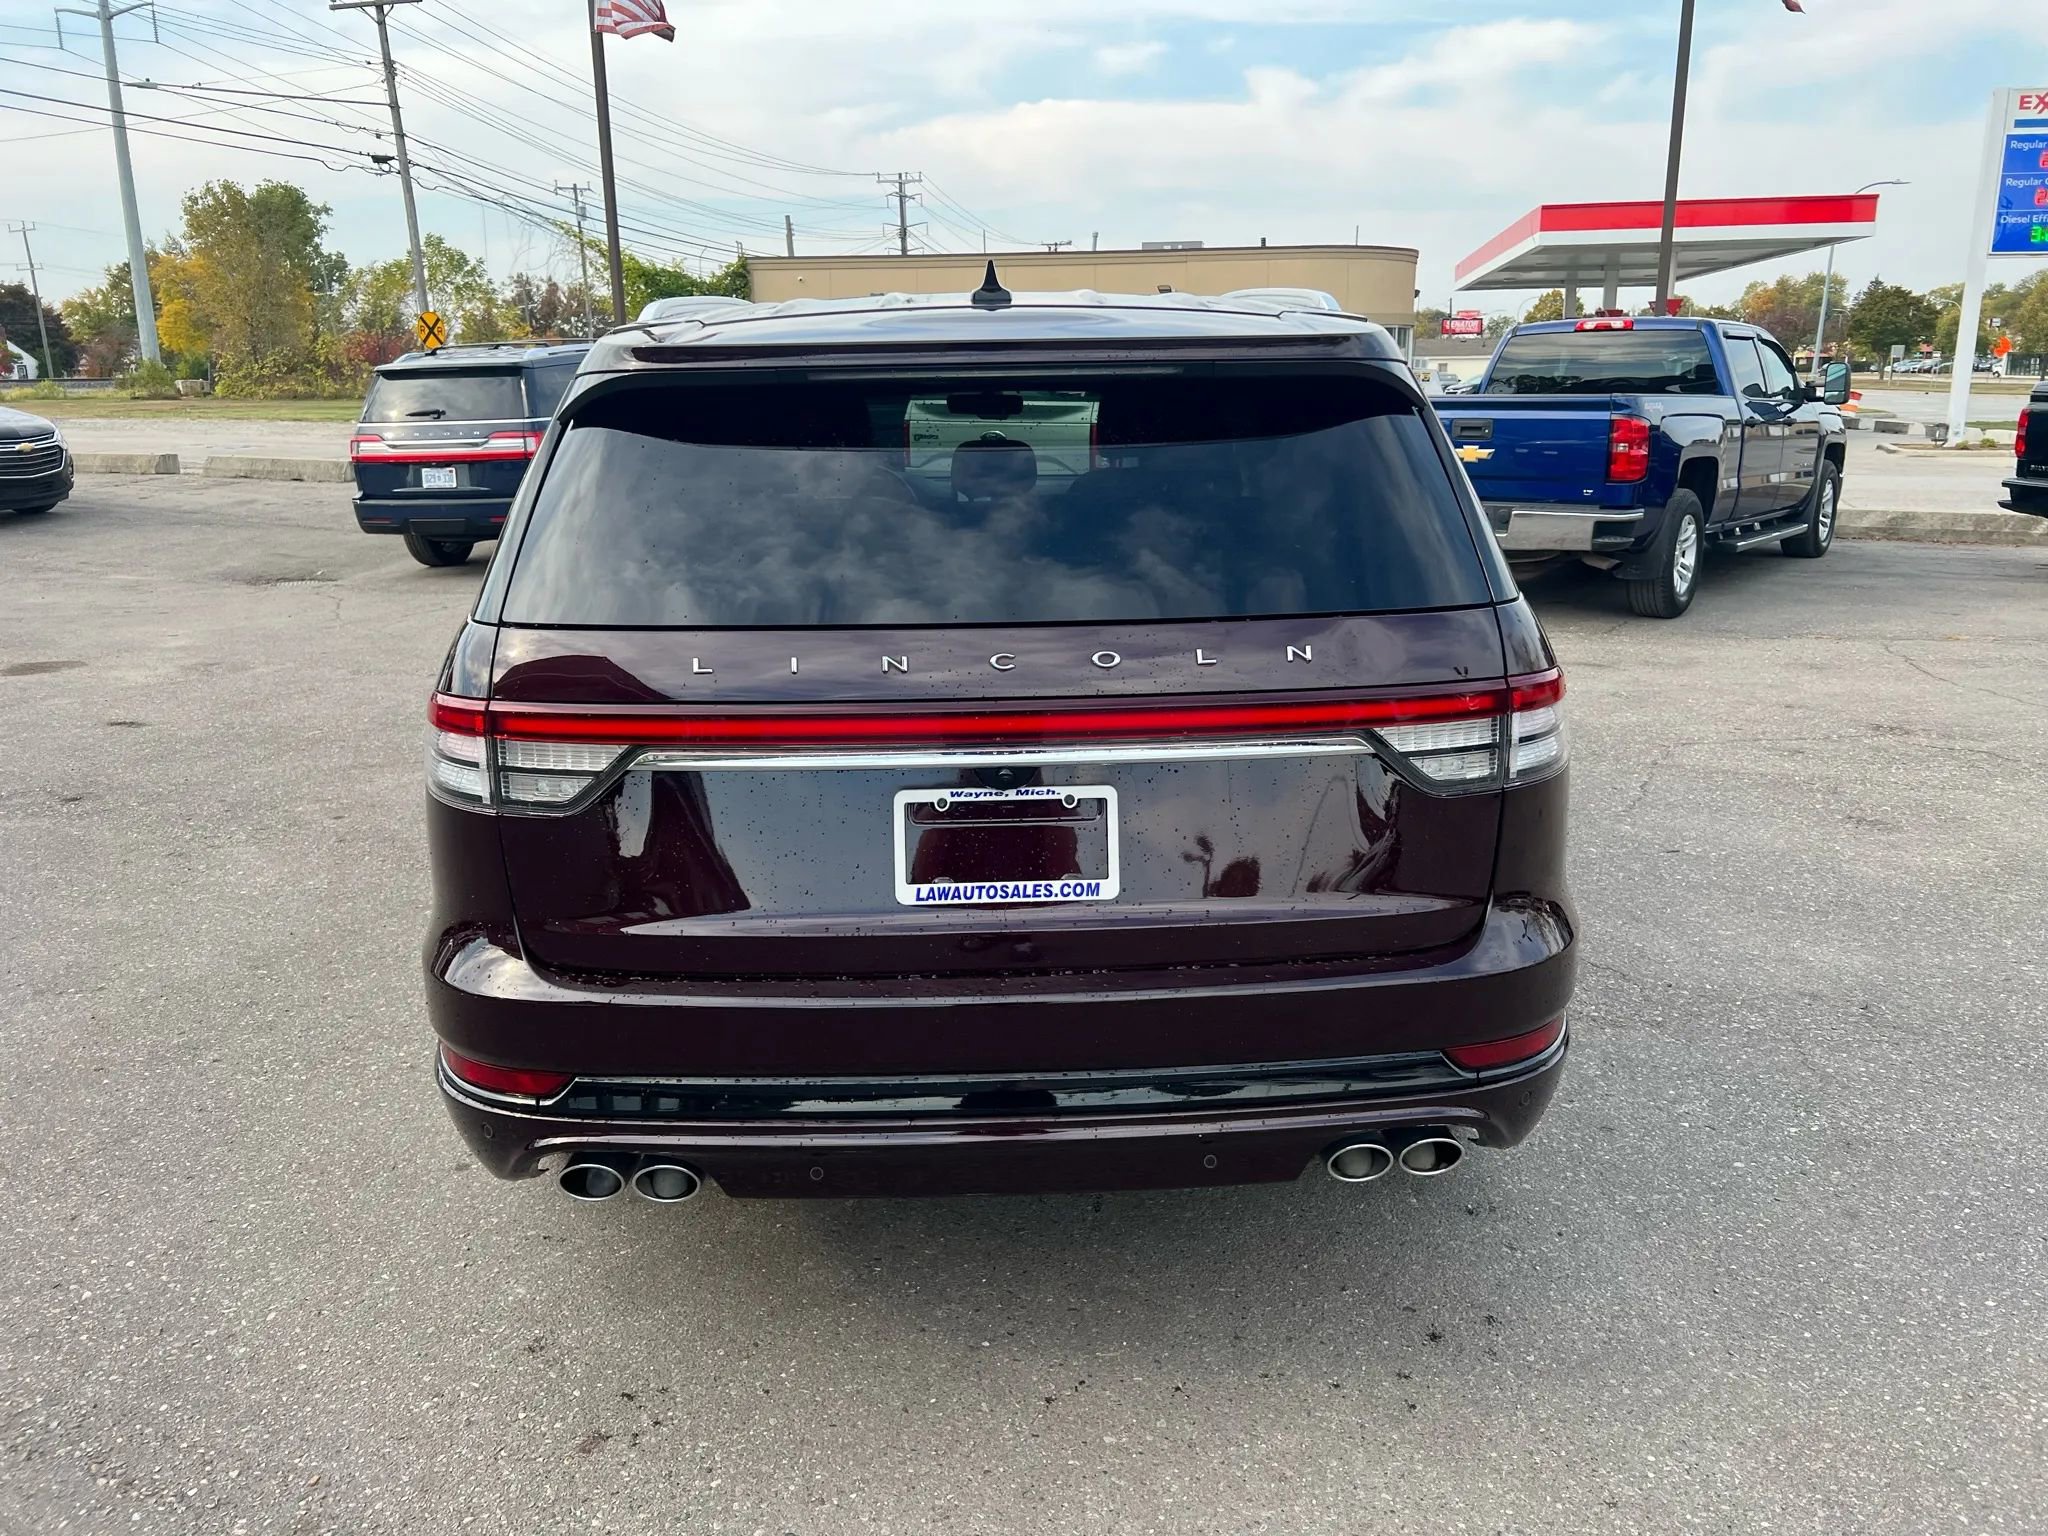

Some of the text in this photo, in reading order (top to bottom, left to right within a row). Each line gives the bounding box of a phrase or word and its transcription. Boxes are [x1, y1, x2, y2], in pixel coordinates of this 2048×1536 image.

[2011, 140, 2047, 151] Regular
[2006, 177, 2043, 188] Regular
[2001, 214, 2030, 224] Diesel
[692, 644, 1312, 674] LINCOLN
[950, 788, 1061, 798] Wayne, Mich.
[915, 882, 1101, 902] LAWAUTOSALES.COM
